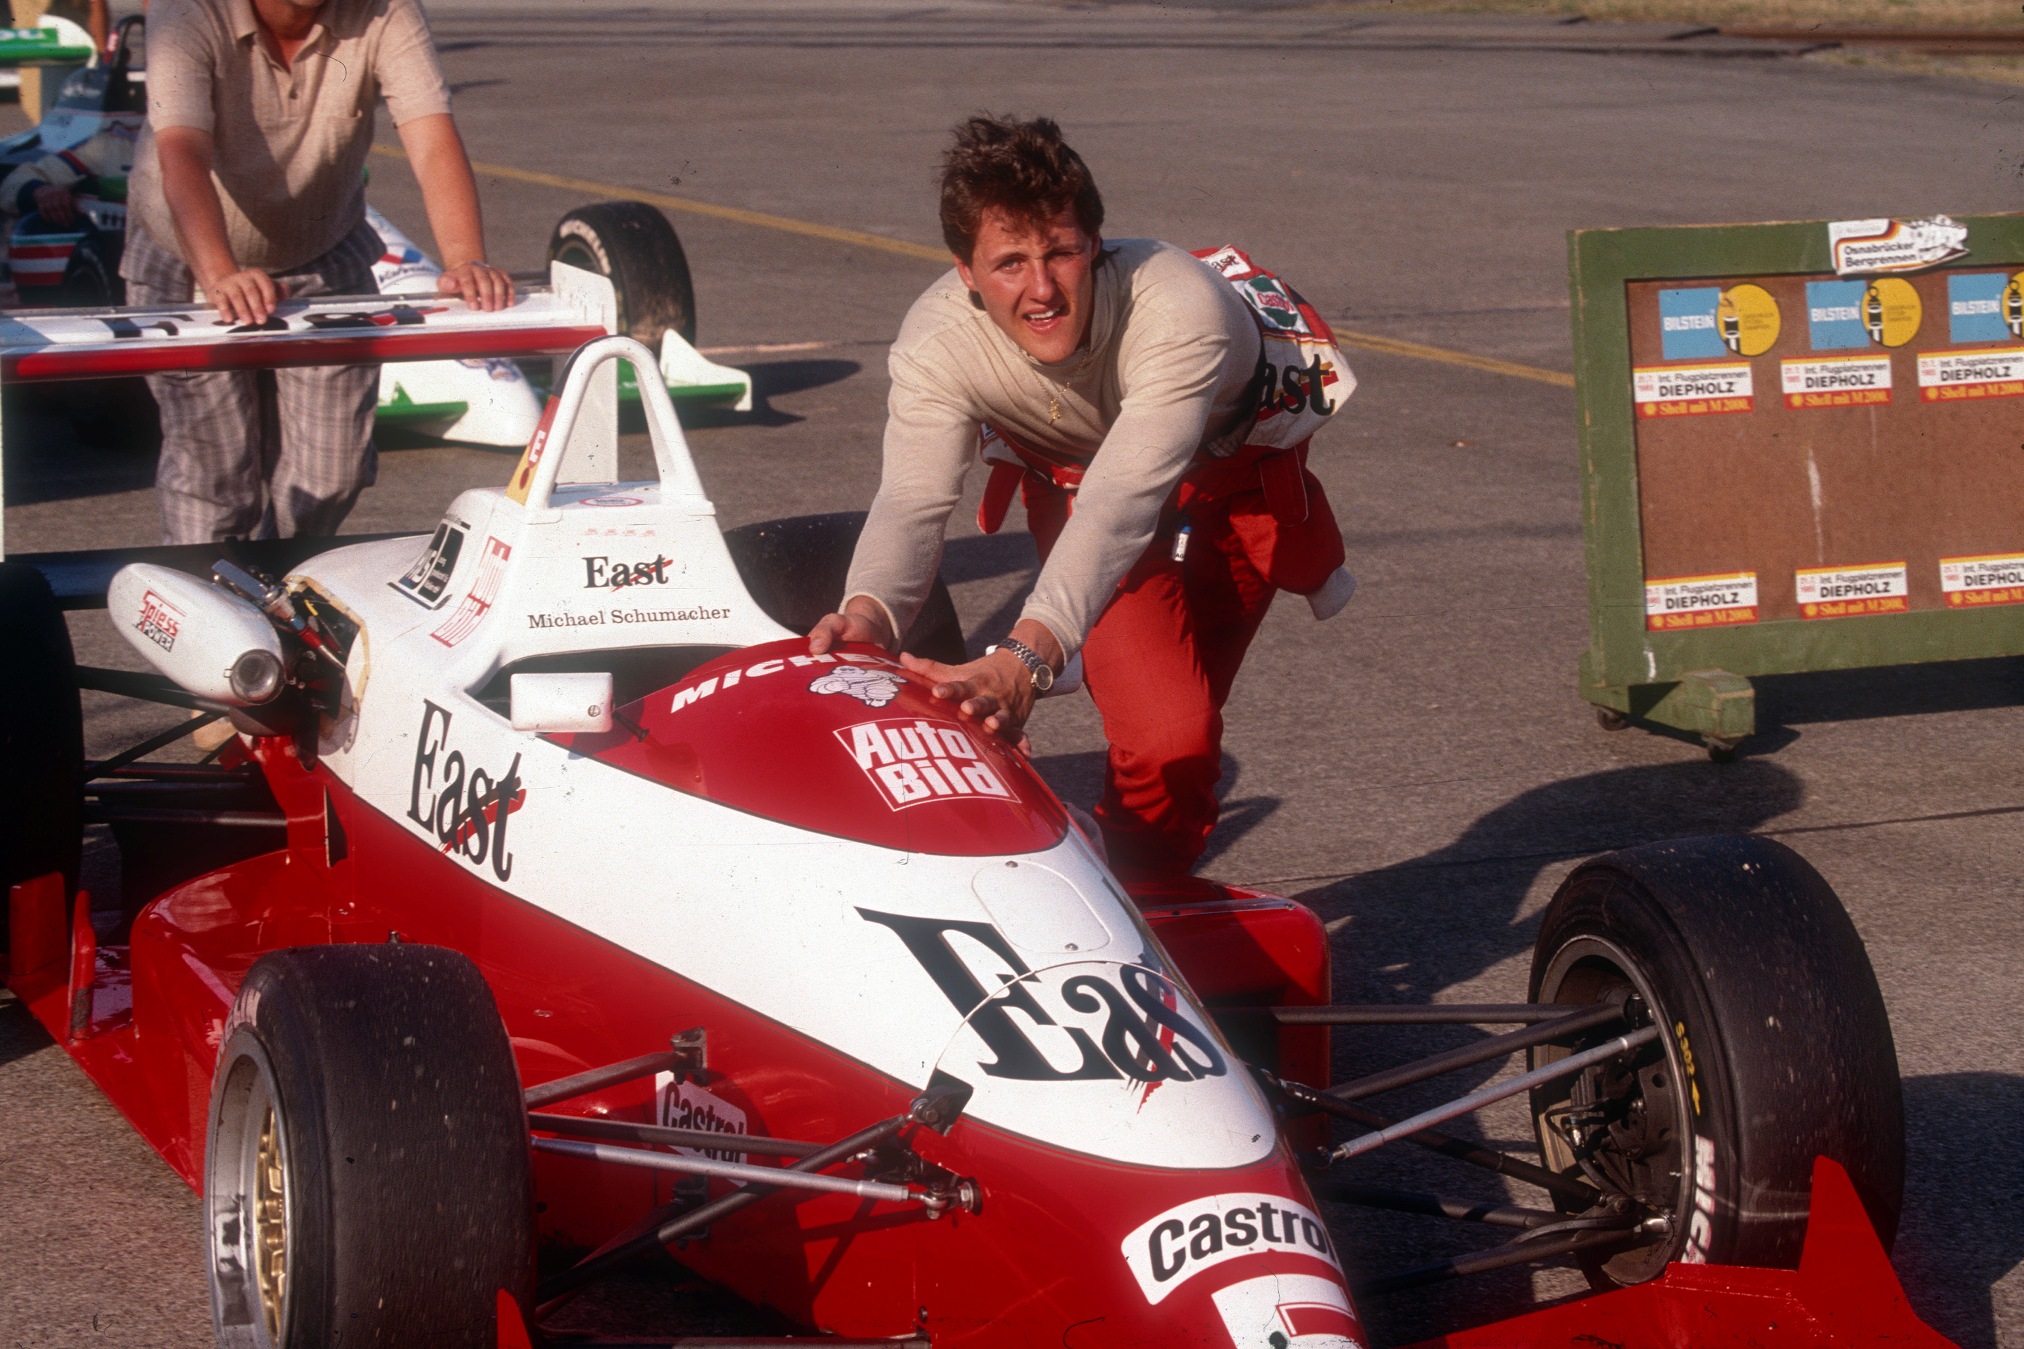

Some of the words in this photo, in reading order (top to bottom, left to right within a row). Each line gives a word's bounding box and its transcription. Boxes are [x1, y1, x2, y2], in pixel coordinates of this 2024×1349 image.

[1811, 306, 1861, 322] BILSTEIN
[1951, 301, 2000, 315] BILSTEIN
[1663, 314, 1716, 331] BILSTEIN
[1805, 373, 1875, 388] DIEPHOLZ
[1941, 366, 2011, 382] DIEPHOLZ
[1660, 381, 1736, 397] DIEPHOLZ
[582, 553, 670, 590] East
[1820, 581, 1890, 598] DIEPHOLZ
[1666, 592, 1739, 609] DIEPHOLZ
[528, 610, 606, 629] Michael
[611, 606, 731, 624] Schumacher
[851, 721, 978, 770] Auto
[875, 758, 1011, 804] Bild
[407, 698, 524, 883] East
[853, 905, 1228, 1083] Eas
